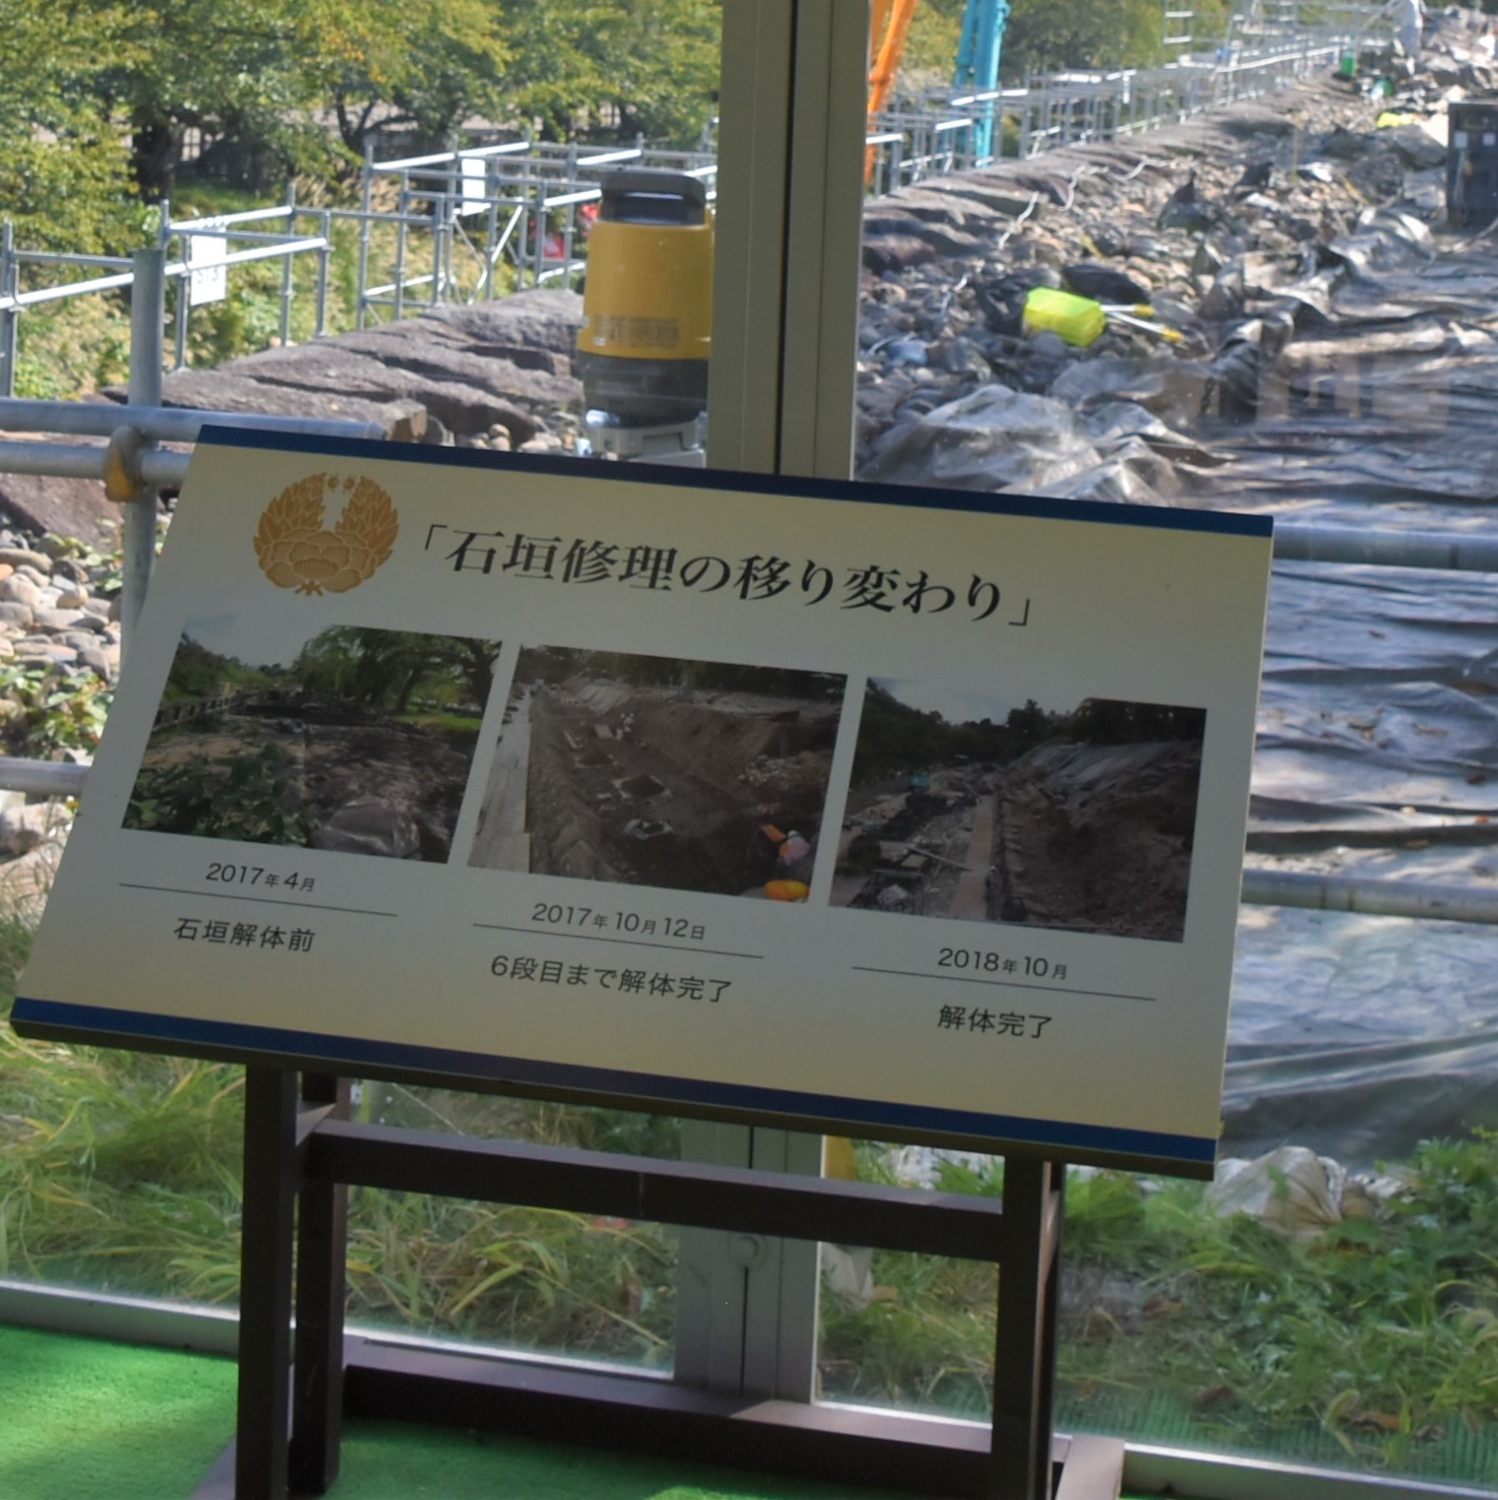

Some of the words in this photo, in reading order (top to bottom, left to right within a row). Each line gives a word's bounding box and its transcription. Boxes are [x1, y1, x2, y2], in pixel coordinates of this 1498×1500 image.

[424, 524, 1031, 627] 「石垣修理の移り変わり」
[205, 862, 316, 892] 2017年4月
[173, 917, 317, 953] 石垣解体前
[491, 955, 733, 1003] 6段目まで解体完了
[937, 947, 1068, 980] 2018年10月
[937, 1004, 1053, 1039] 解体完了
